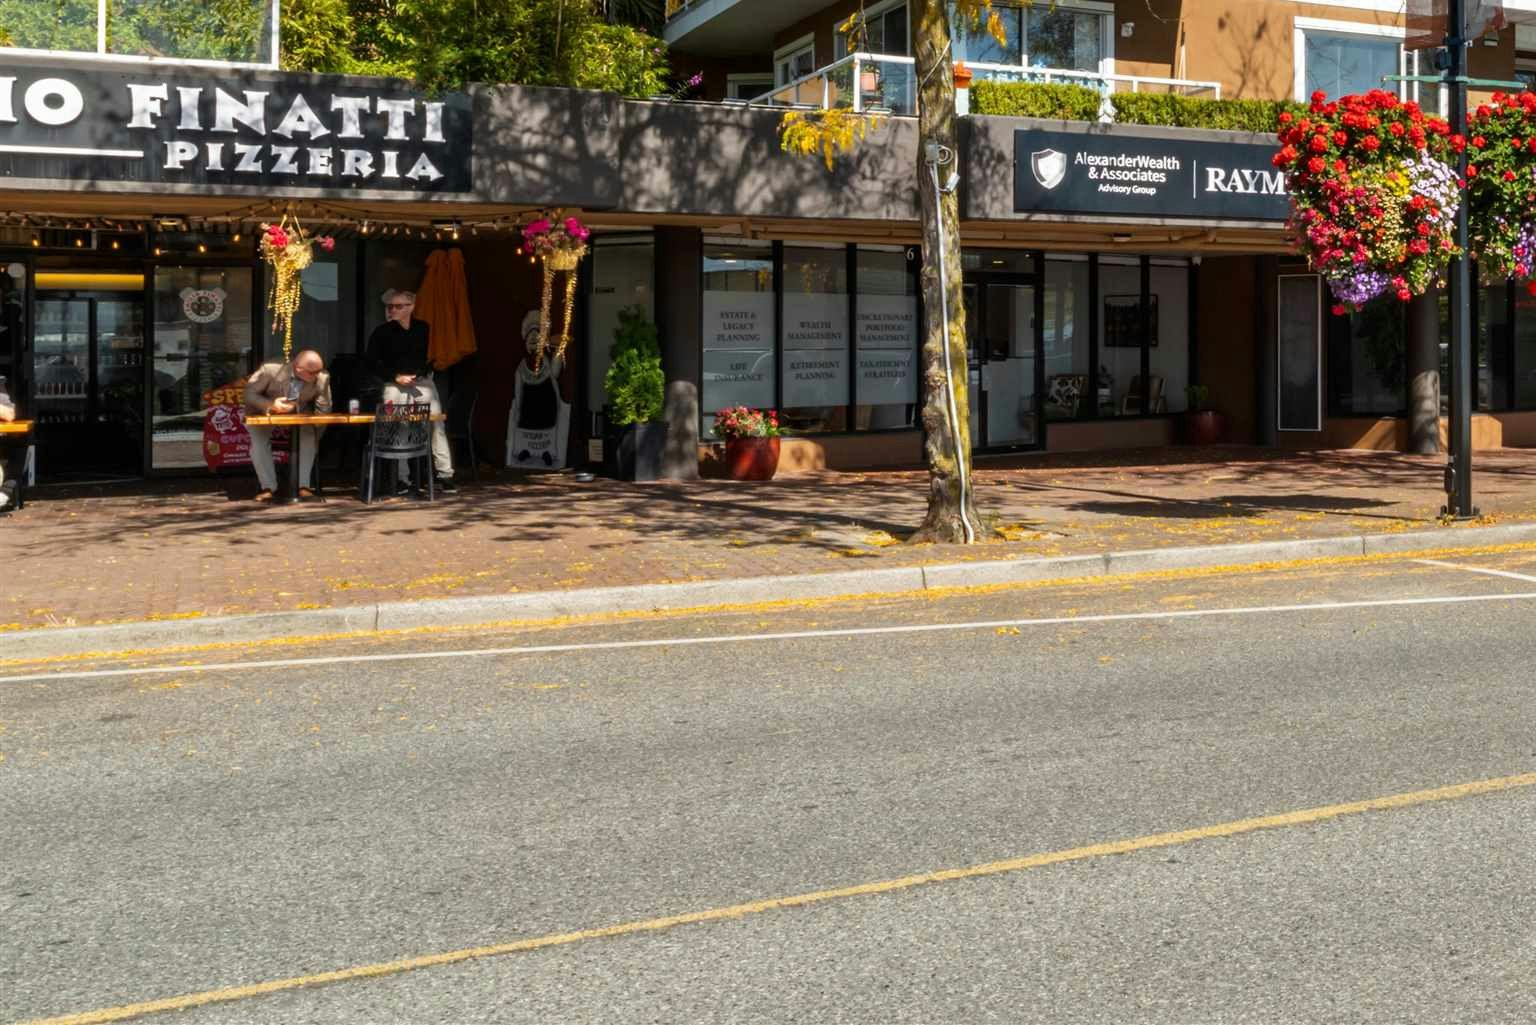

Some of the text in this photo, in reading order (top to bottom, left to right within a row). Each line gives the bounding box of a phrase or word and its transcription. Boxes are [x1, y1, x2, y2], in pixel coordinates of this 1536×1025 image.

[126, 83, 446, 143] FINATTI
[163, 140, 444, 181] PIZZERIA
[1074, 151, 1180, 170] AlexanderWealth
[1088, 166, 1167, 182] & Associates
[1205, 167, 1289, 195] RAYM
[1098, 183, 1157, 196] Advisory Group
[906, 247, 915, 261] 6
[720, 311, 749, 319] ESTATE
[716, 334, 761, 342] PLANNING
